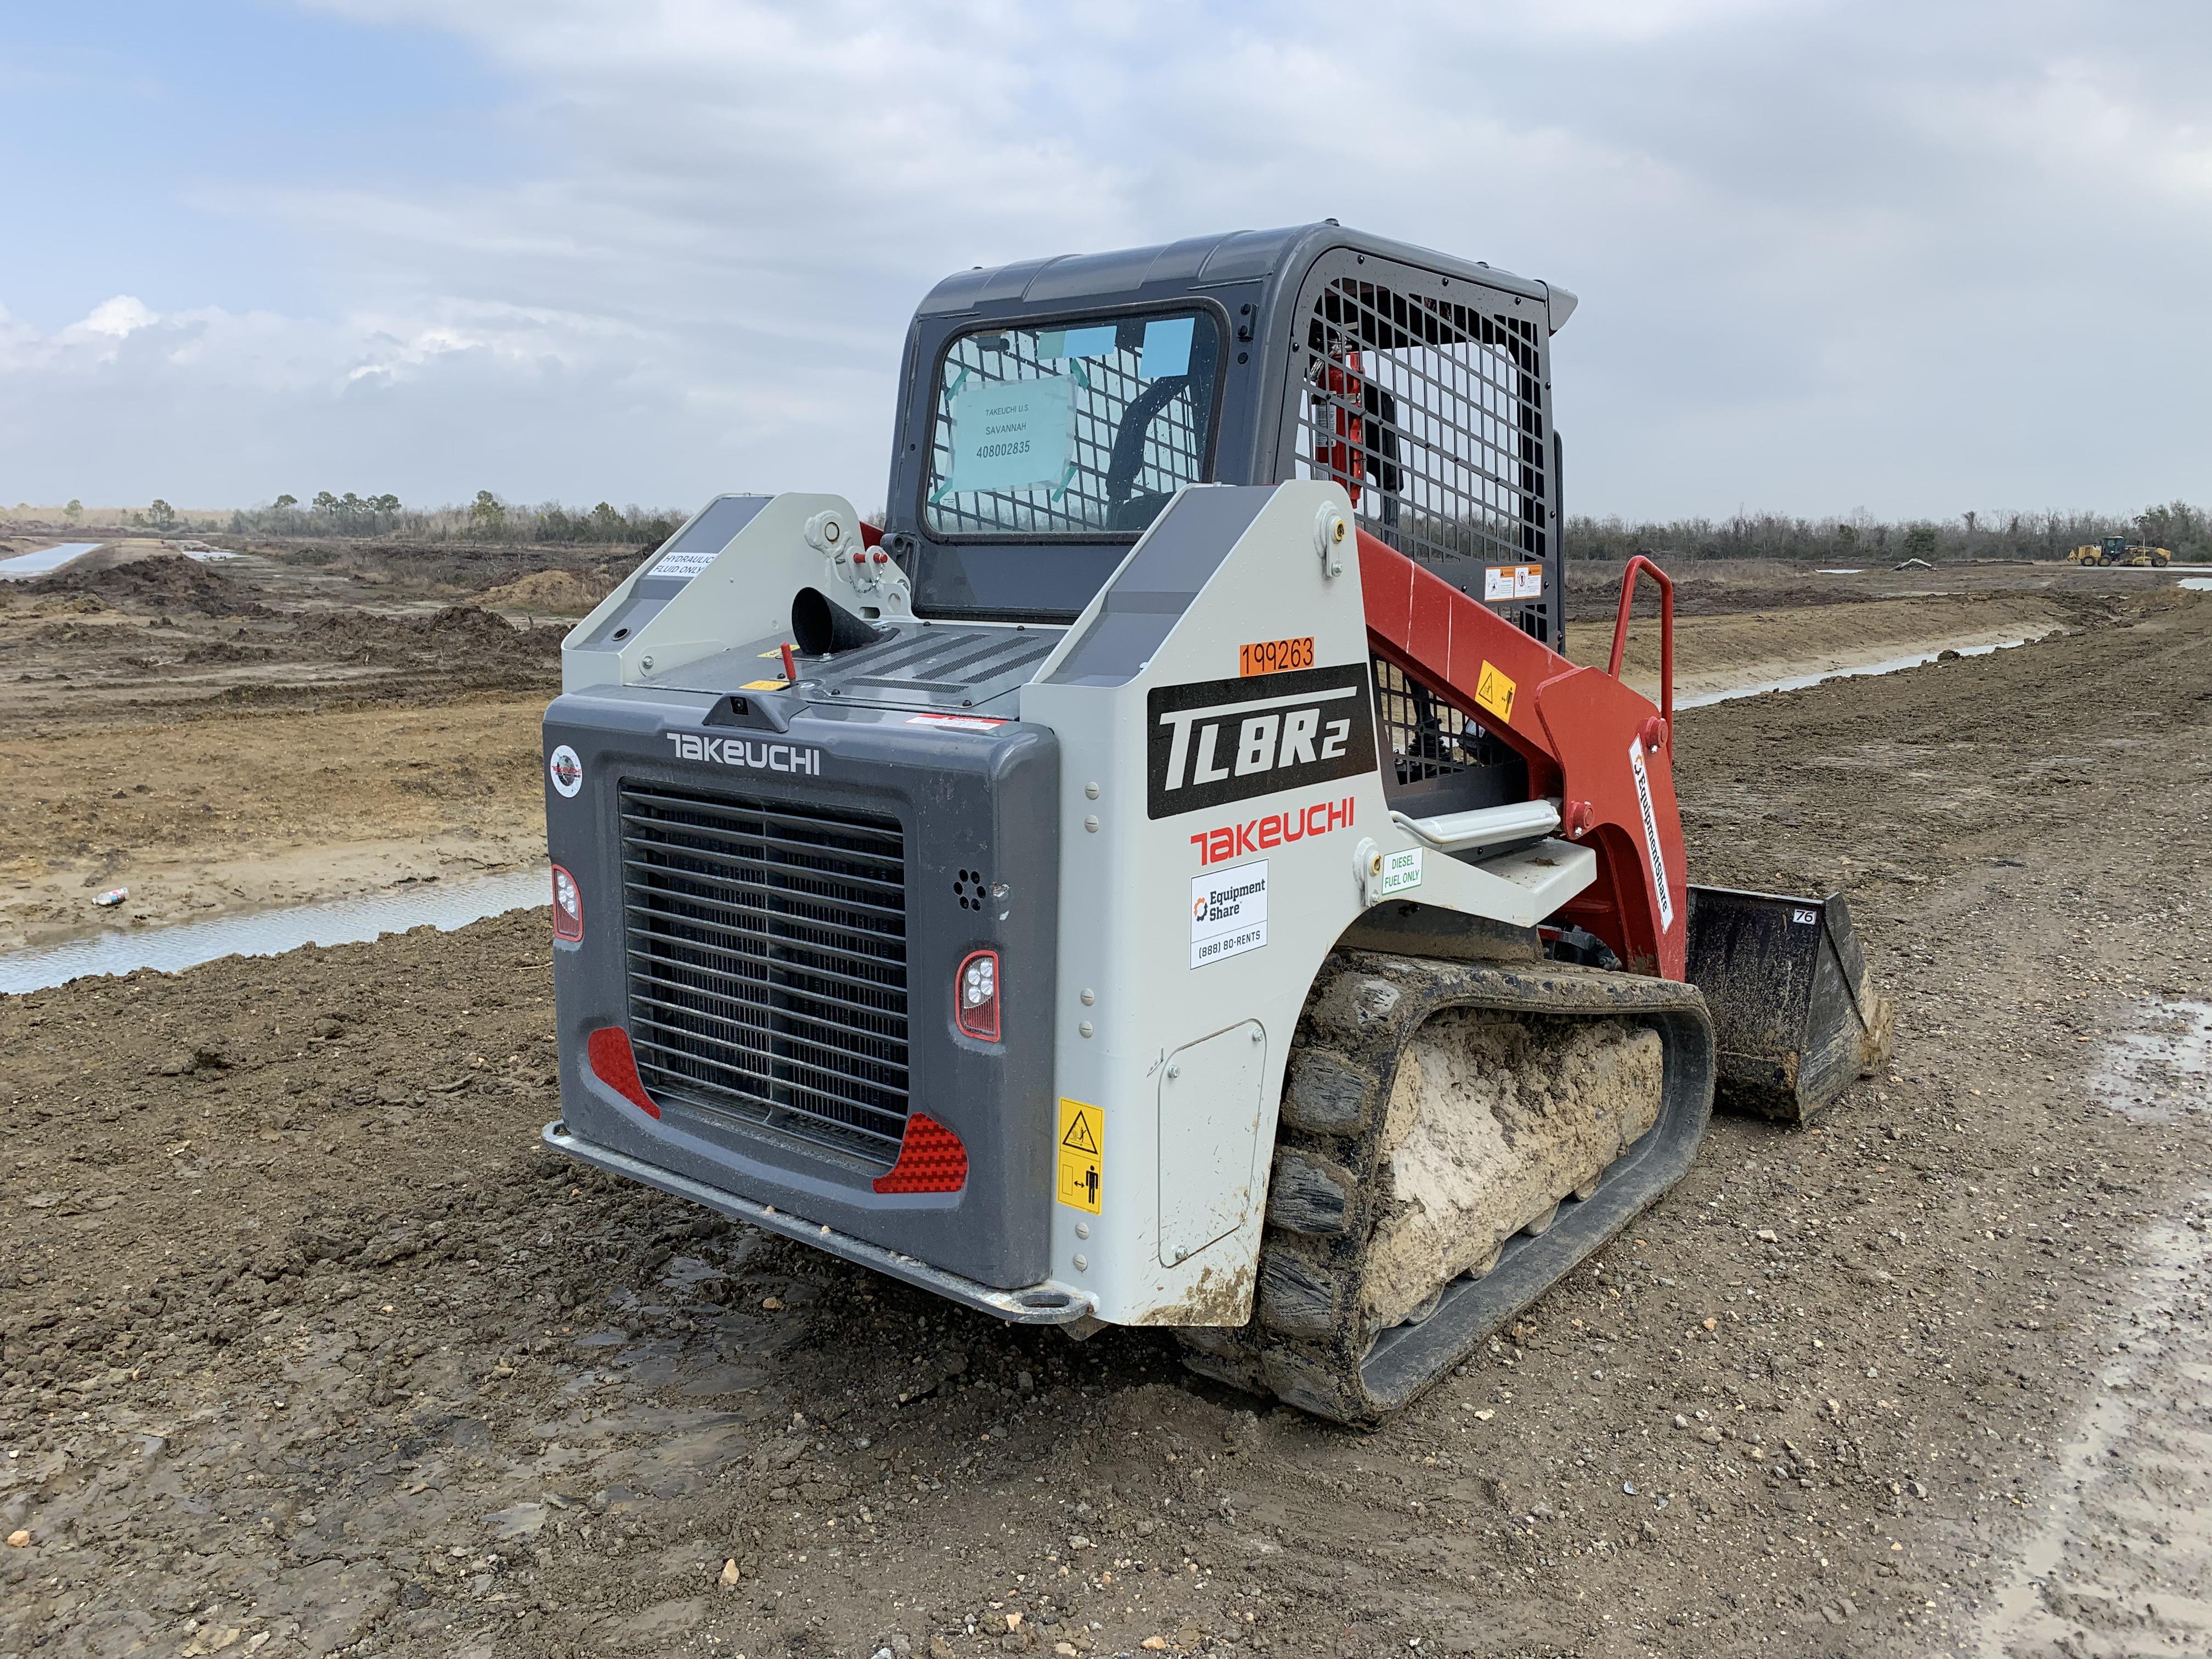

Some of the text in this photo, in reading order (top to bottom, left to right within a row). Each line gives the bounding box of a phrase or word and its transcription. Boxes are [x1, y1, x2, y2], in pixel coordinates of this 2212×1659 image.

[985, 405, 1017, 416] TAKEUCHI
[985, 422, 1026, 435] SAVANNAH
[976, 440, 1030, 458] 408002835
[663, 555, 715, 563] HYDRAULIC
[679, 566, 705, 574] ONLY
[1242, 636, 1314, 675] 199263
[1159, 685, 1358, 791] TL8R2
[1638, 772, 1667, 912] EquipmentShare
[1392, 854, 1414, 870] DIESEL
[1384, 869, 1420, 888] FUEL ONLY
[1210, 878, 1266, 906] Equipment
[1209, 904, 1240, 922] Share
[1796, 910, 1813, 922] 76
[1199, 930, 1261, 959] (888) 80-RENTS
